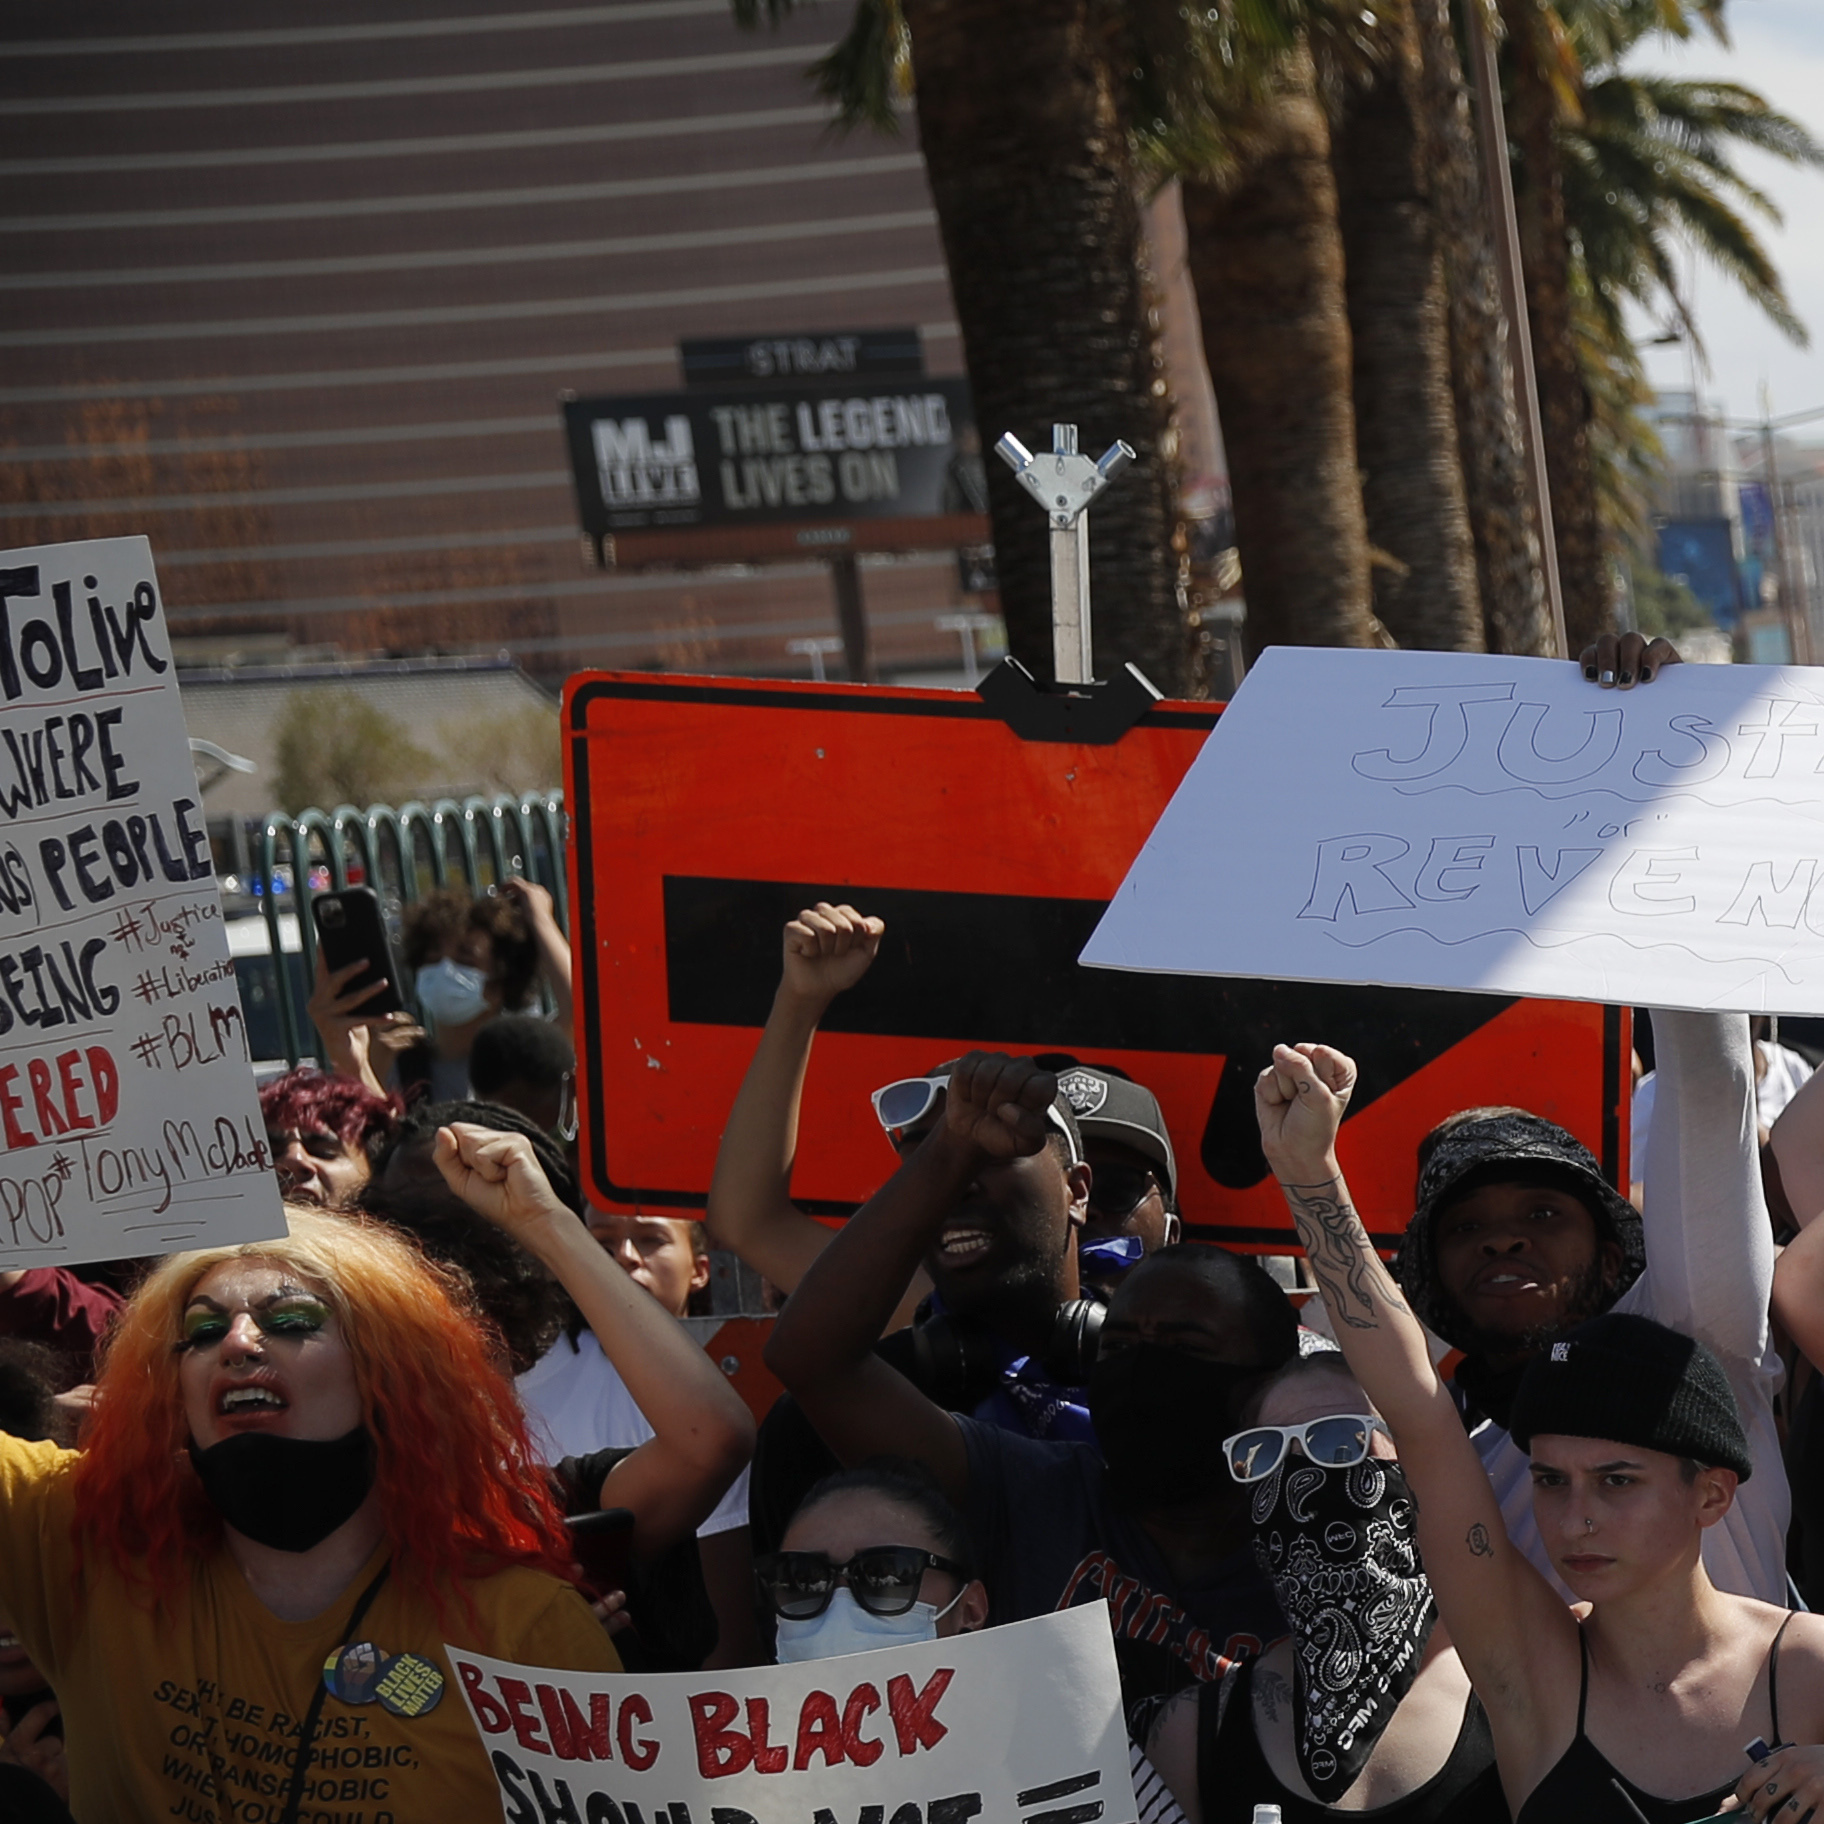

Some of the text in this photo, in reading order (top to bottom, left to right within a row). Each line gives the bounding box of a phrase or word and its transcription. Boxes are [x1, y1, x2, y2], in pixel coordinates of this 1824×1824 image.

[749, 335, 861, 377] STRAT
[710, 403, 795, 458] THE
[796, 392, 953, 454] LEGEND
[719, 452, 835, 510] LIVES
[838, 450, 900, 502] ON
[38, 797, 212, 912] PEOPLE
[107, 899, 222, 954] #Justice
[129, 1002, 249, 1073] #BLM
[374, 1652, 420, 1701] BLACK
[388, 1661, 432, 1709] LIVES
[400, 1670, 445, 1718] MATTER
[225, 1696, 265, 1727] BE
[455, 1659, 958, 1780] BEING BLACK
